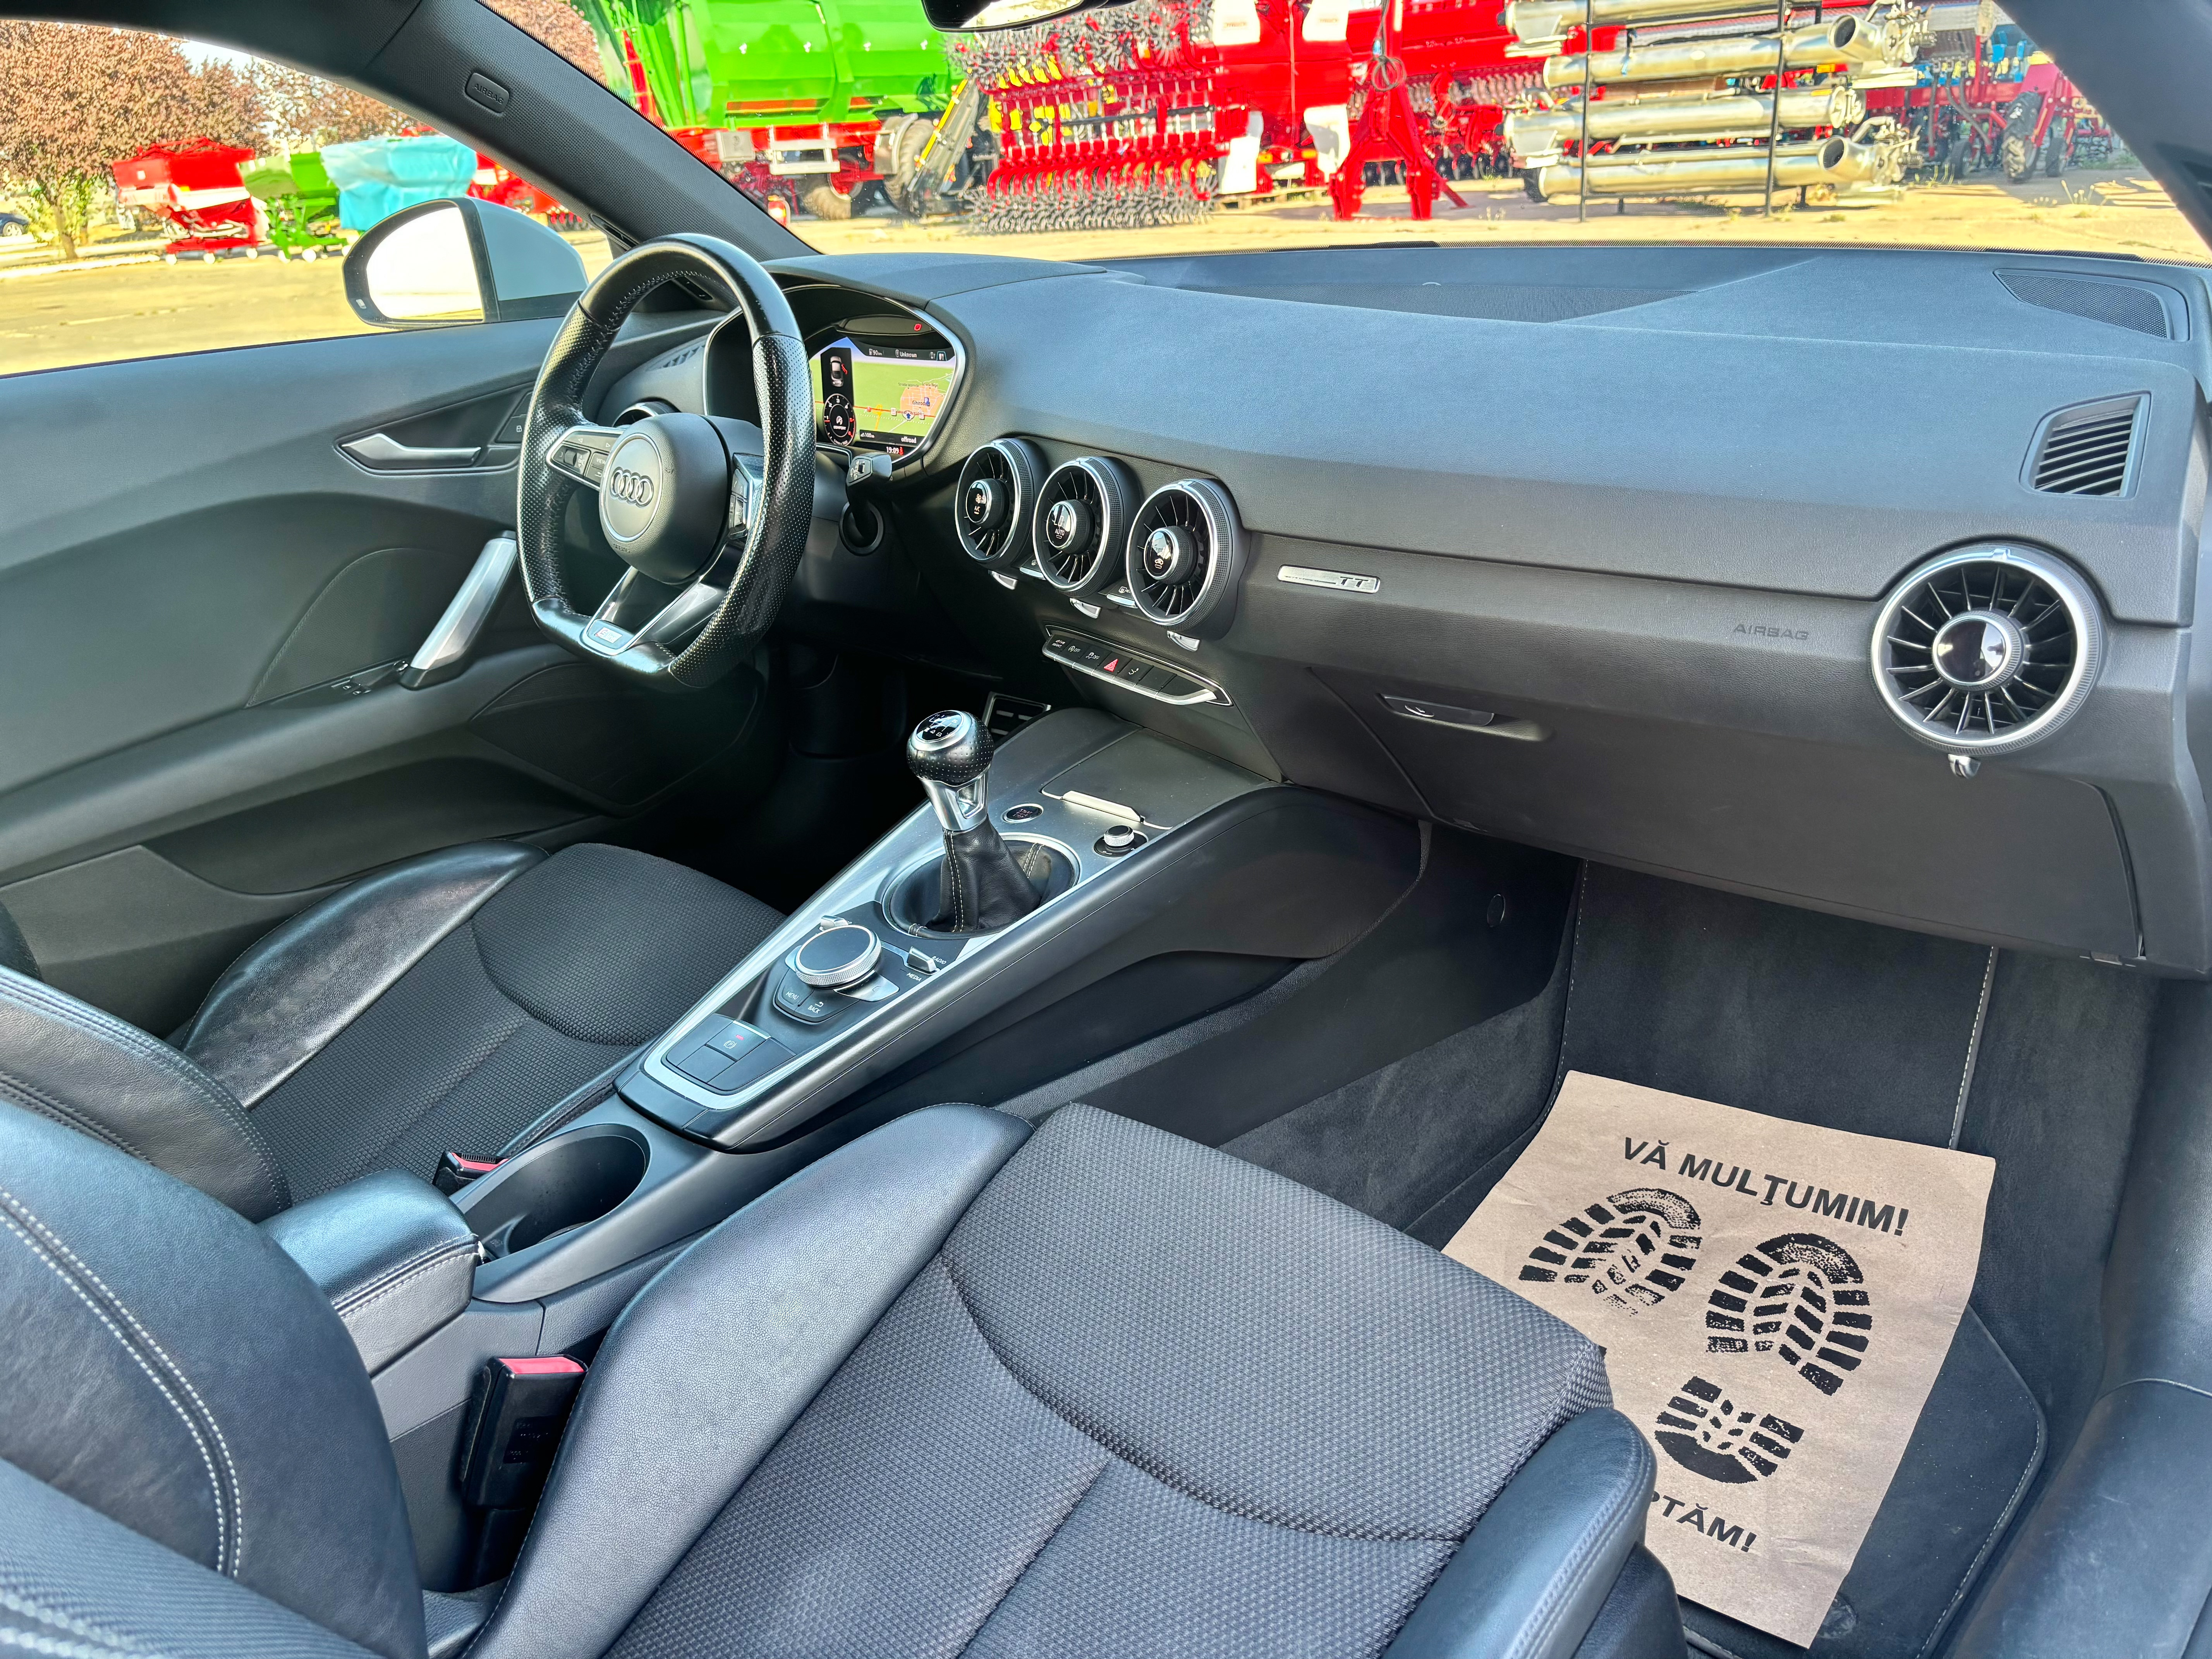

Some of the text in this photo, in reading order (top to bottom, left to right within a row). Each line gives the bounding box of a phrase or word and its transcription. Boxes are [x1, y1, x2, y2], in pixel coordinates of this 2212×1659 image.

[473, 83, 504, 105] AIRBAG
[886, 446, 899, 454] 19:09
[1340, 576, 1369, 587] TT
[1733, 624, 1809, 640] AIRBAG
[931, 956, 947, 965] RADIO
[906, 972, 922, 982] MEDIA
[785, 991, 799, 1000] MENU
[807, 1005, 821, 1014] BACK
[1625, 1137, 1670, 1170] VĂ
